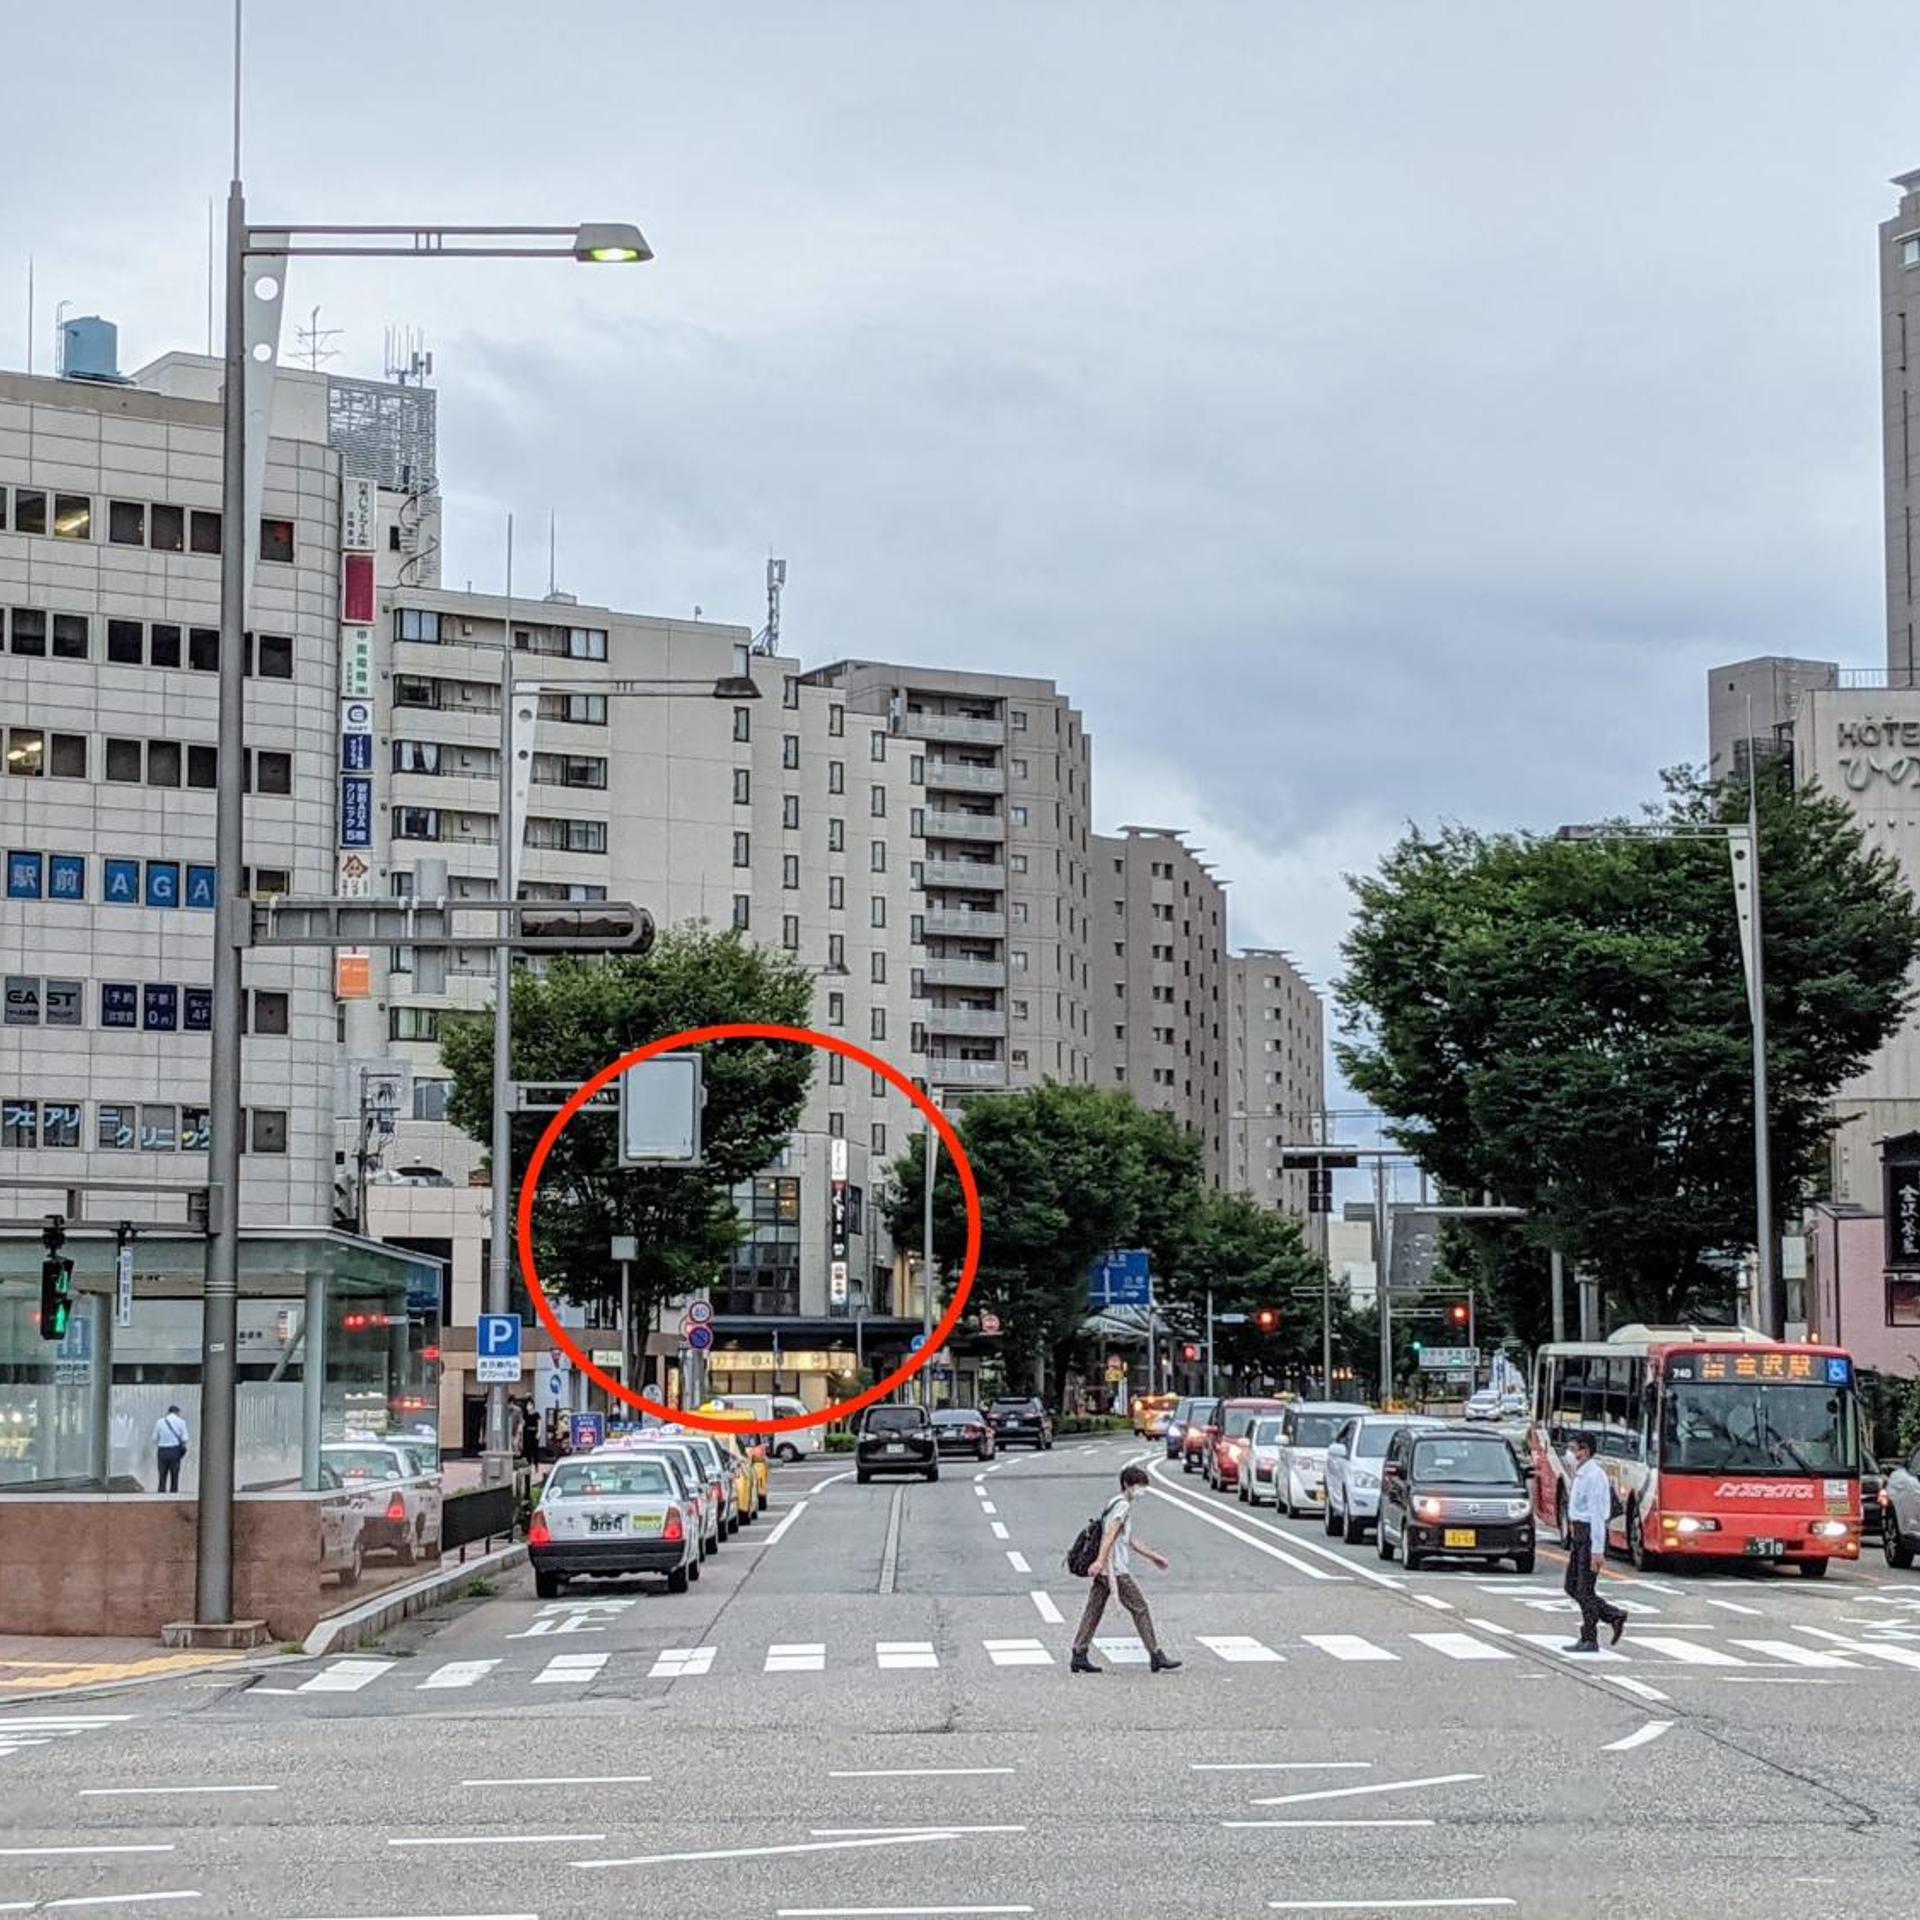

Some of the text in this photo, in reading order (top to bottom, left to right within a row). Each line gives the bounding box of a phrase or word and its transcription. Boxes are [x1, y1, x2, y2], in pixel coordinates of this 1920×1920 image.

[488, 1319, 512, 1352] P
[1734, 1353, 1812, 1377] 金沢駅
